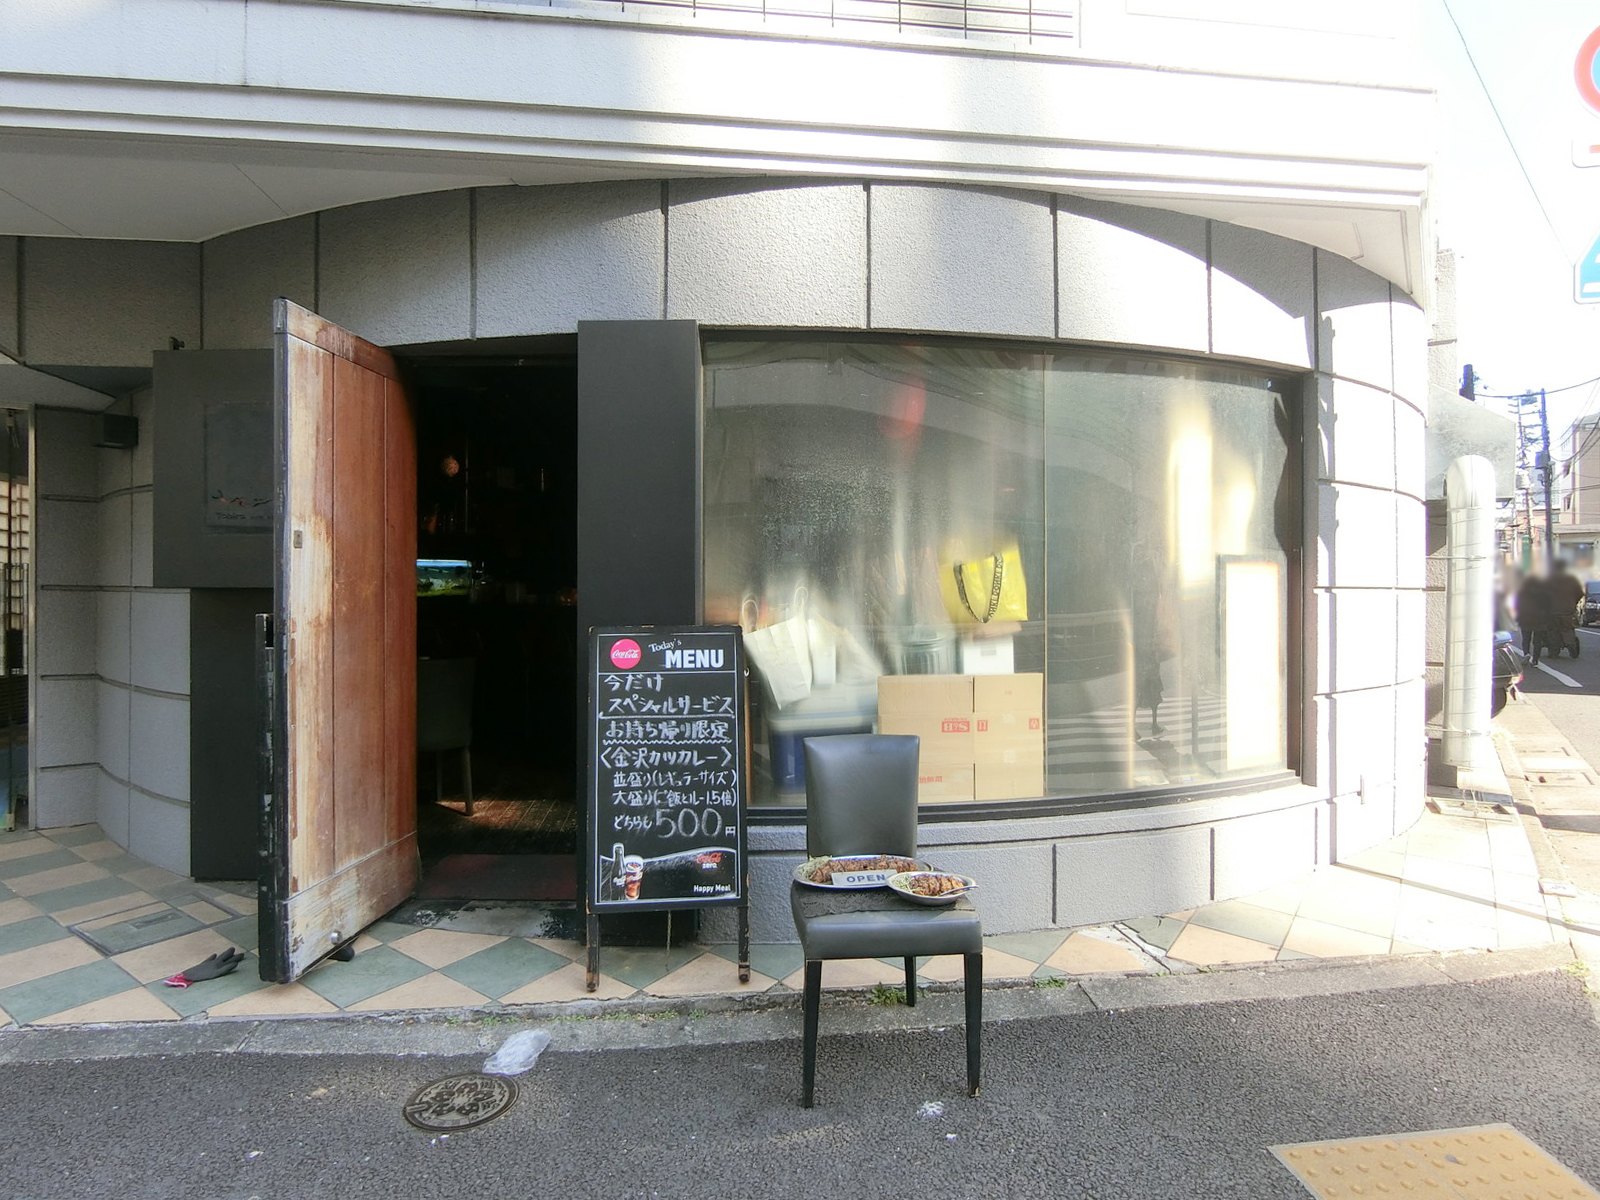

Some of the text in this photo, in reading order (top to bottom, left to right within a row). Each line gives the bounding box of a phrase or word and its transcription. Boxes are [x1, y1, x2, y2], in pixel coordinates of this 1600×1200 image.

[648, 638, 682, 652] Today's
[665, 649, 724, 668] MENU
[604, 674, 663, 692] 今だけ
[608, 694, 734, 715] スペシャルサービス
[606, 720, 729, 739] お持ち帰り限定
[846, 874, 885, 882] OPEN
[693, 883, 731, 893] Happy Meal
